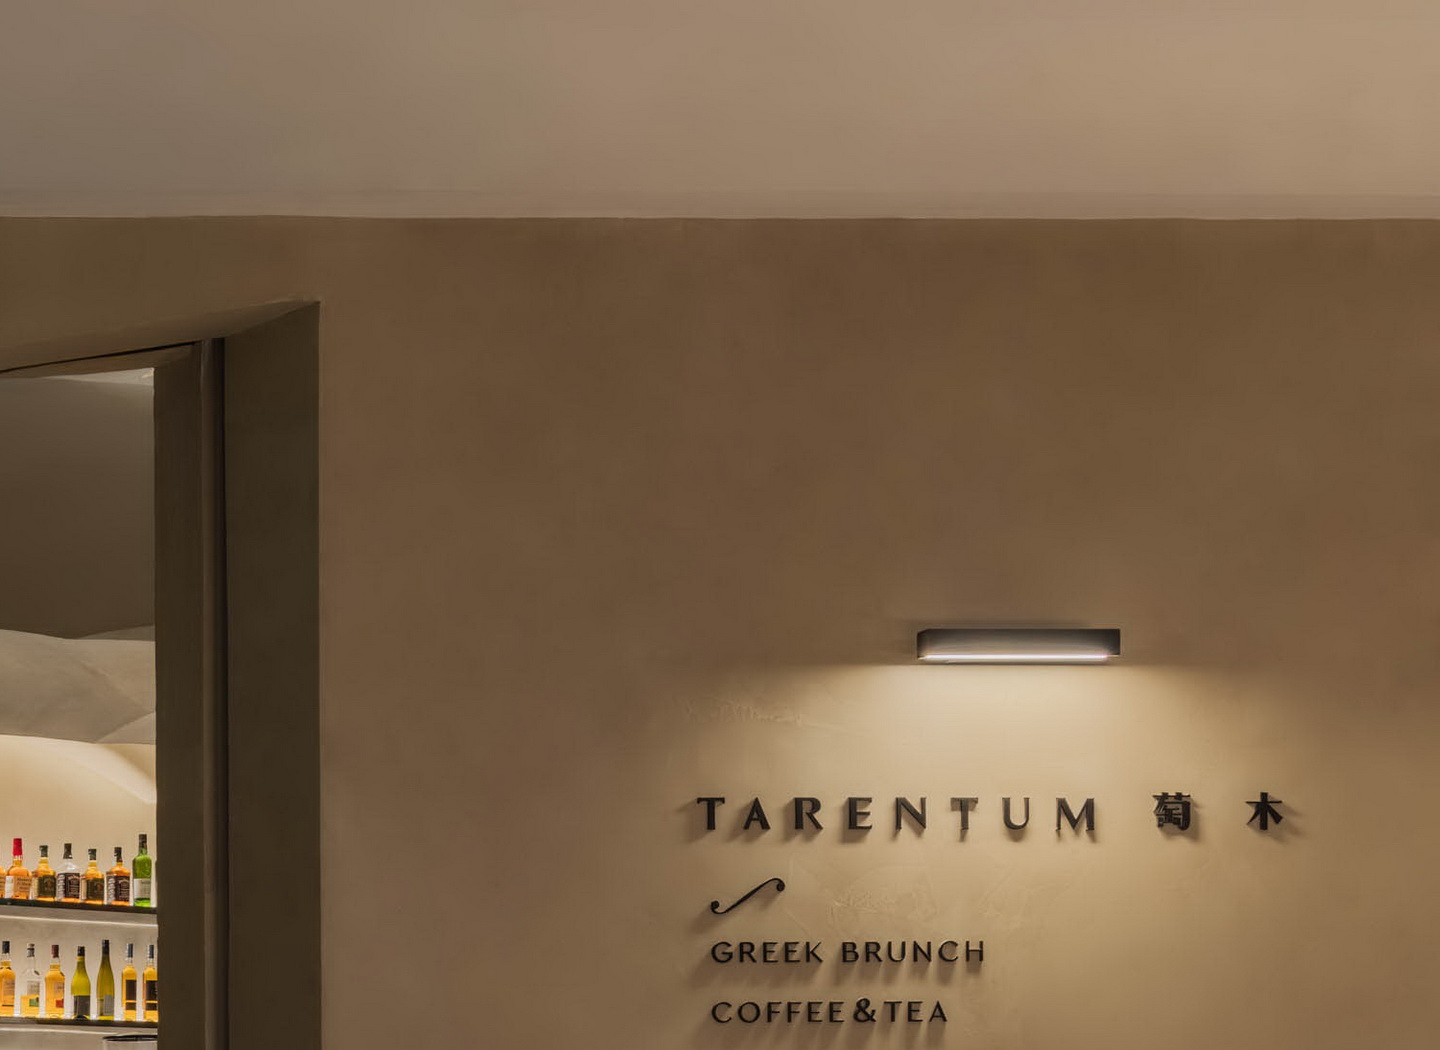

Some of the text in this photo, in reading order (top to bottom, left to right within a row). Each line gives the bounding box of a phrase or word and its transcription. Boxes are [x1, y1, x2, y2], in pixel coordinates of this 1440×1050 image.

[696, 796, 1095, 831] TARENTUM
[710, 940, 985, 964] GREEK BRUNCH
